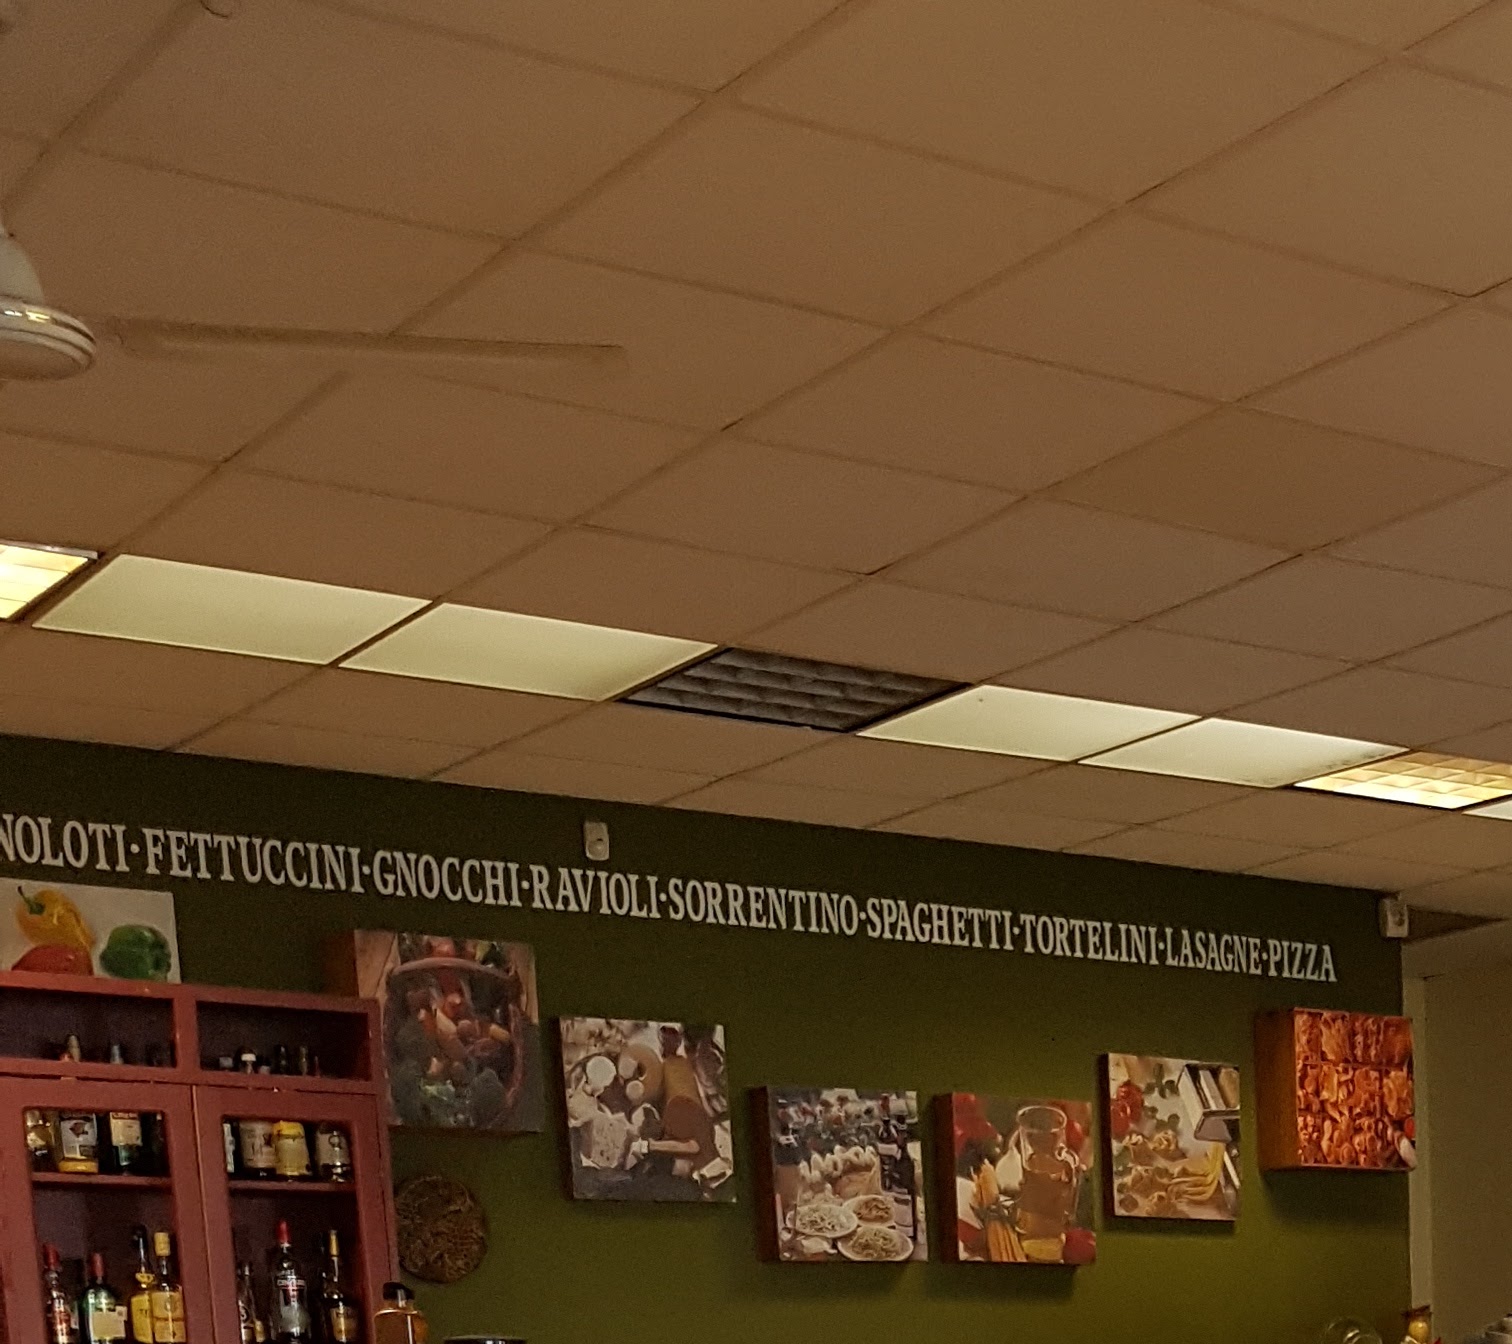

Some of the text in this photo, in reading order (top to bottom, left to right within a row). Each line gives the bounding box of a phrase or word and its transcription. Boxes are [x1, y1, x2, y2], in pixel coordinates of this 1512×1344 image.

[142, 828, 364, 893] FETTUCCINI
[373, 850, 522, 907] GNOCCHI
[529, 865, 661, 918] RAVIOLI
[668, 878, 858, 935] SORRENTINO
[867, 898, 1014, 950] SPAGHETTI
[1020, 914, 1159, 964] TORTELINI
[1164, 928, 1261, 974] LASAGNE
[1268, 940, 1336, 981] PIZZA
